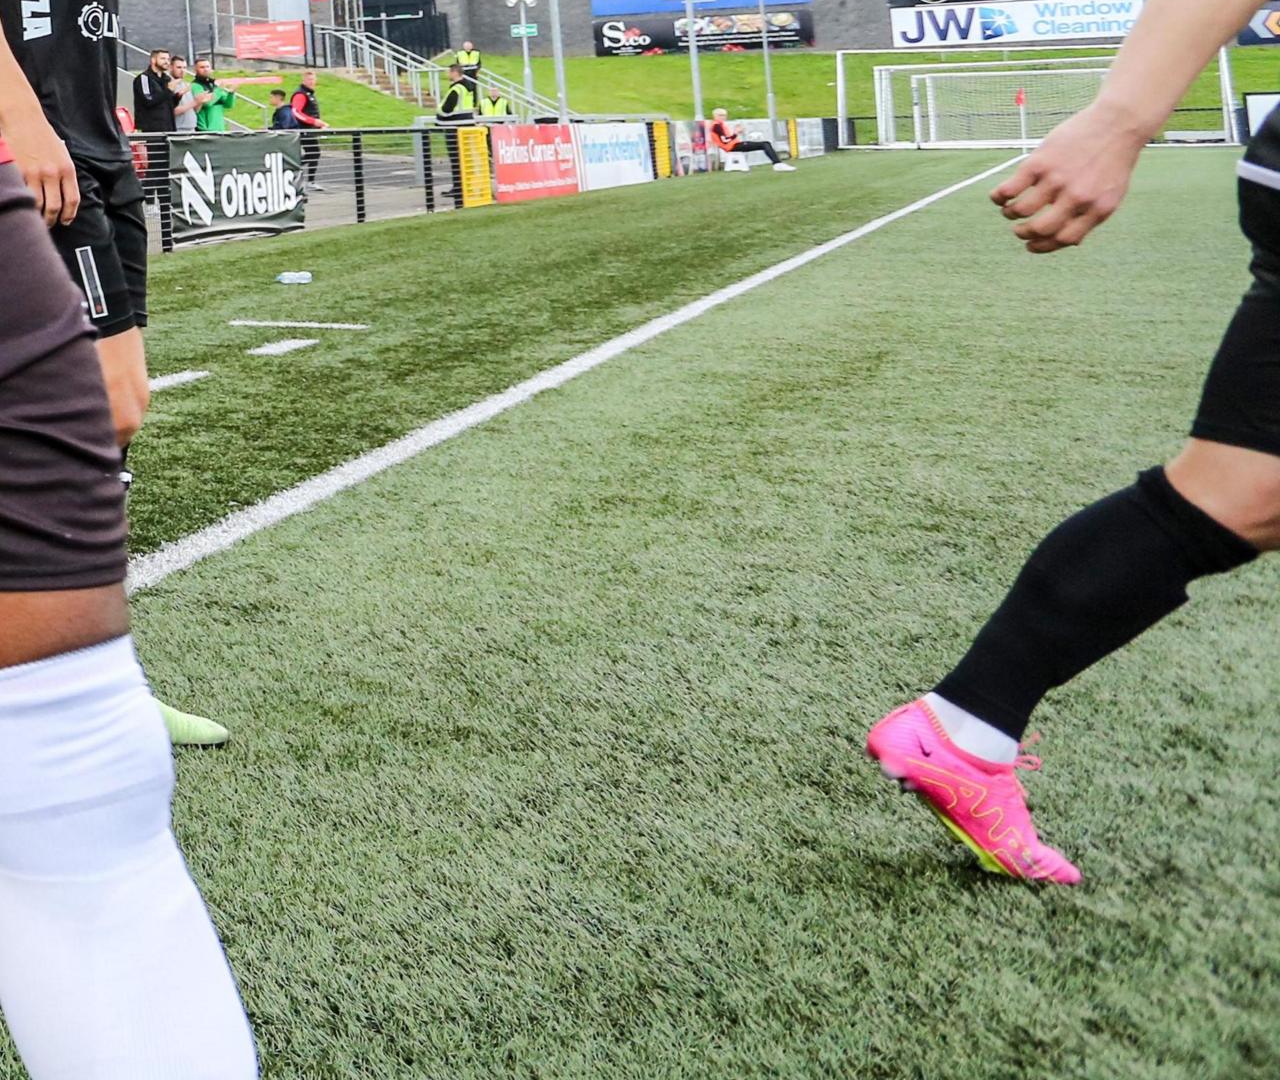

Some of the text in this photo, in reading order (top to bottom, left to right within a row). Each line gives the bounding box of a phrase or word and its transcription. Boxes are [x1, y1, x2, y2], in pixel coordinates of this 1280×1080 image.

[1034, 1, 1133, 18] Window
[900, 7, 975, 44] JW
[1033, 17, 1134, 37] Cleaning
